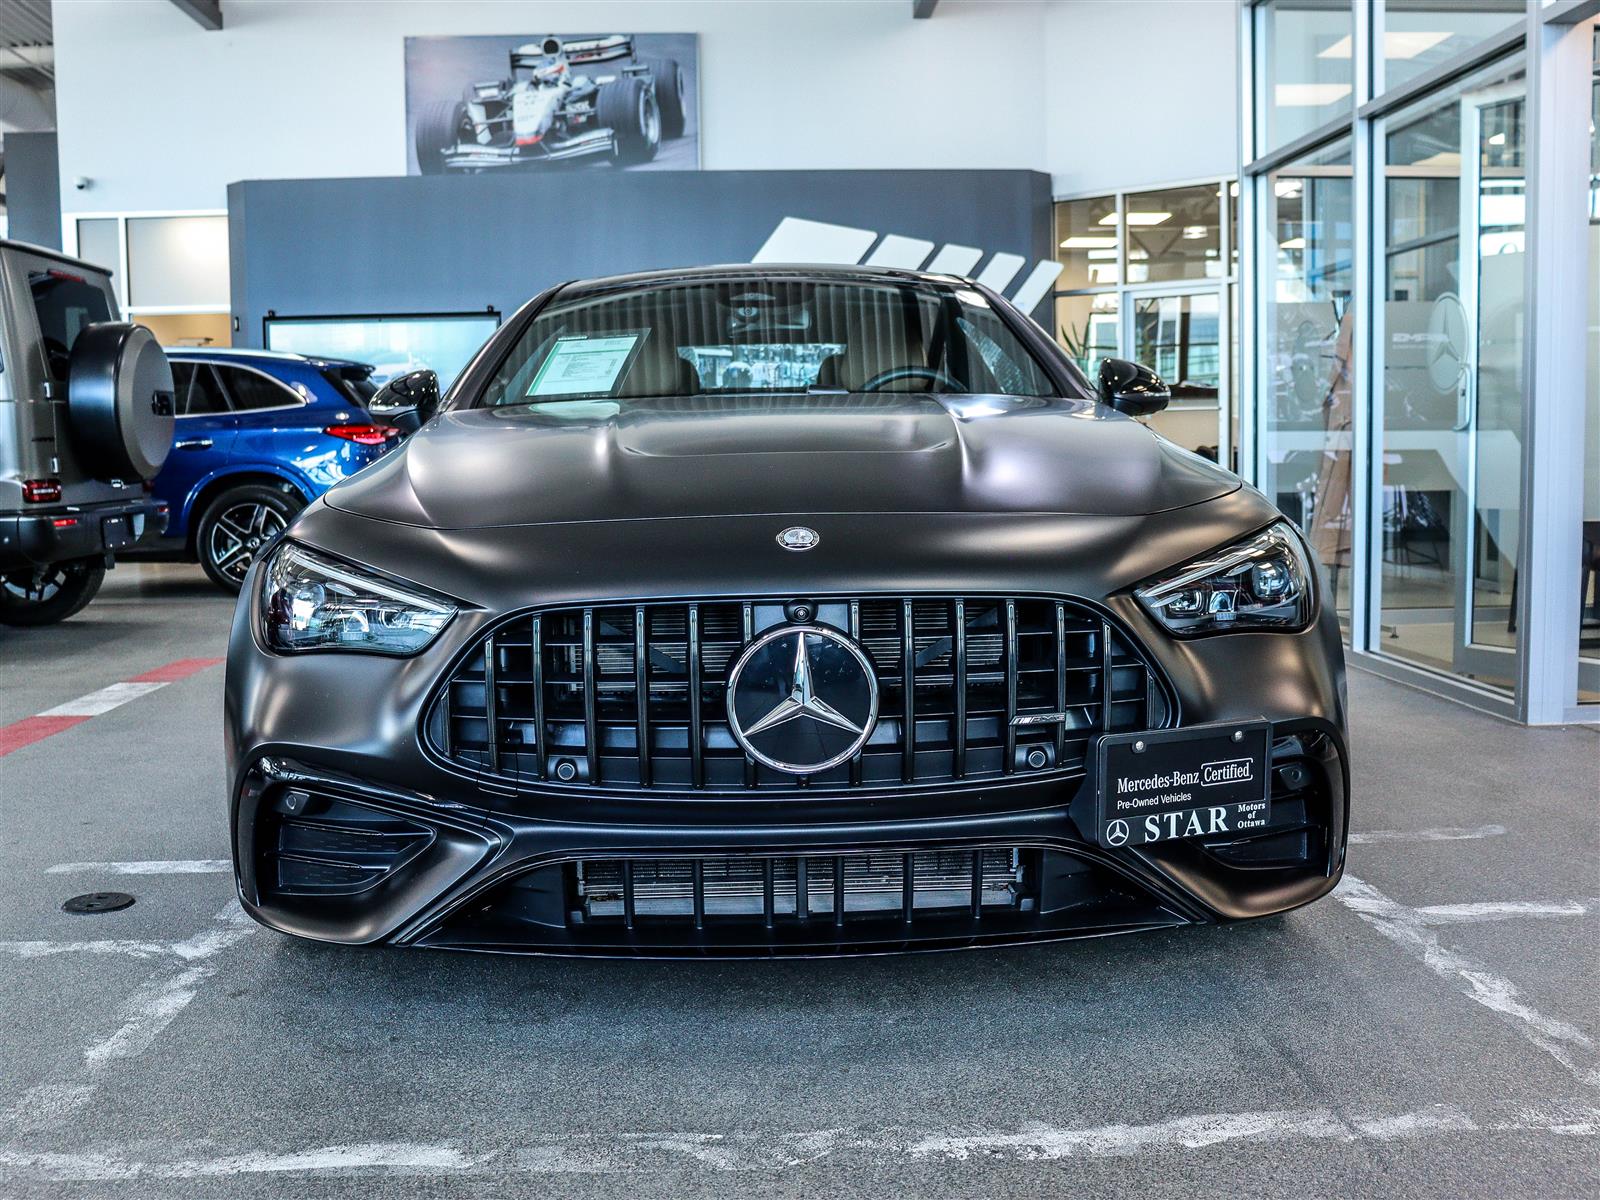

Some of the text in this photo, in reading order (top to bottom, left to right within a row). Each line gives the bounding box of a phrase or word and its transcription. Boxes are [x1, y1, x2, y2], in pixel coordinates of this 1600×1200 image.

[1117, 762, 1250, 794] Mercedes-Benz Certified
[1117, 792, 1192, 810] Pre-Owned Vehicles
[1237, 802, 1266, 813] Motors
[1247, 811, 1256, 820] of
[1144, 806, 1230, 843] STAR
[1237, 819, 1266, 829] Ottawa
